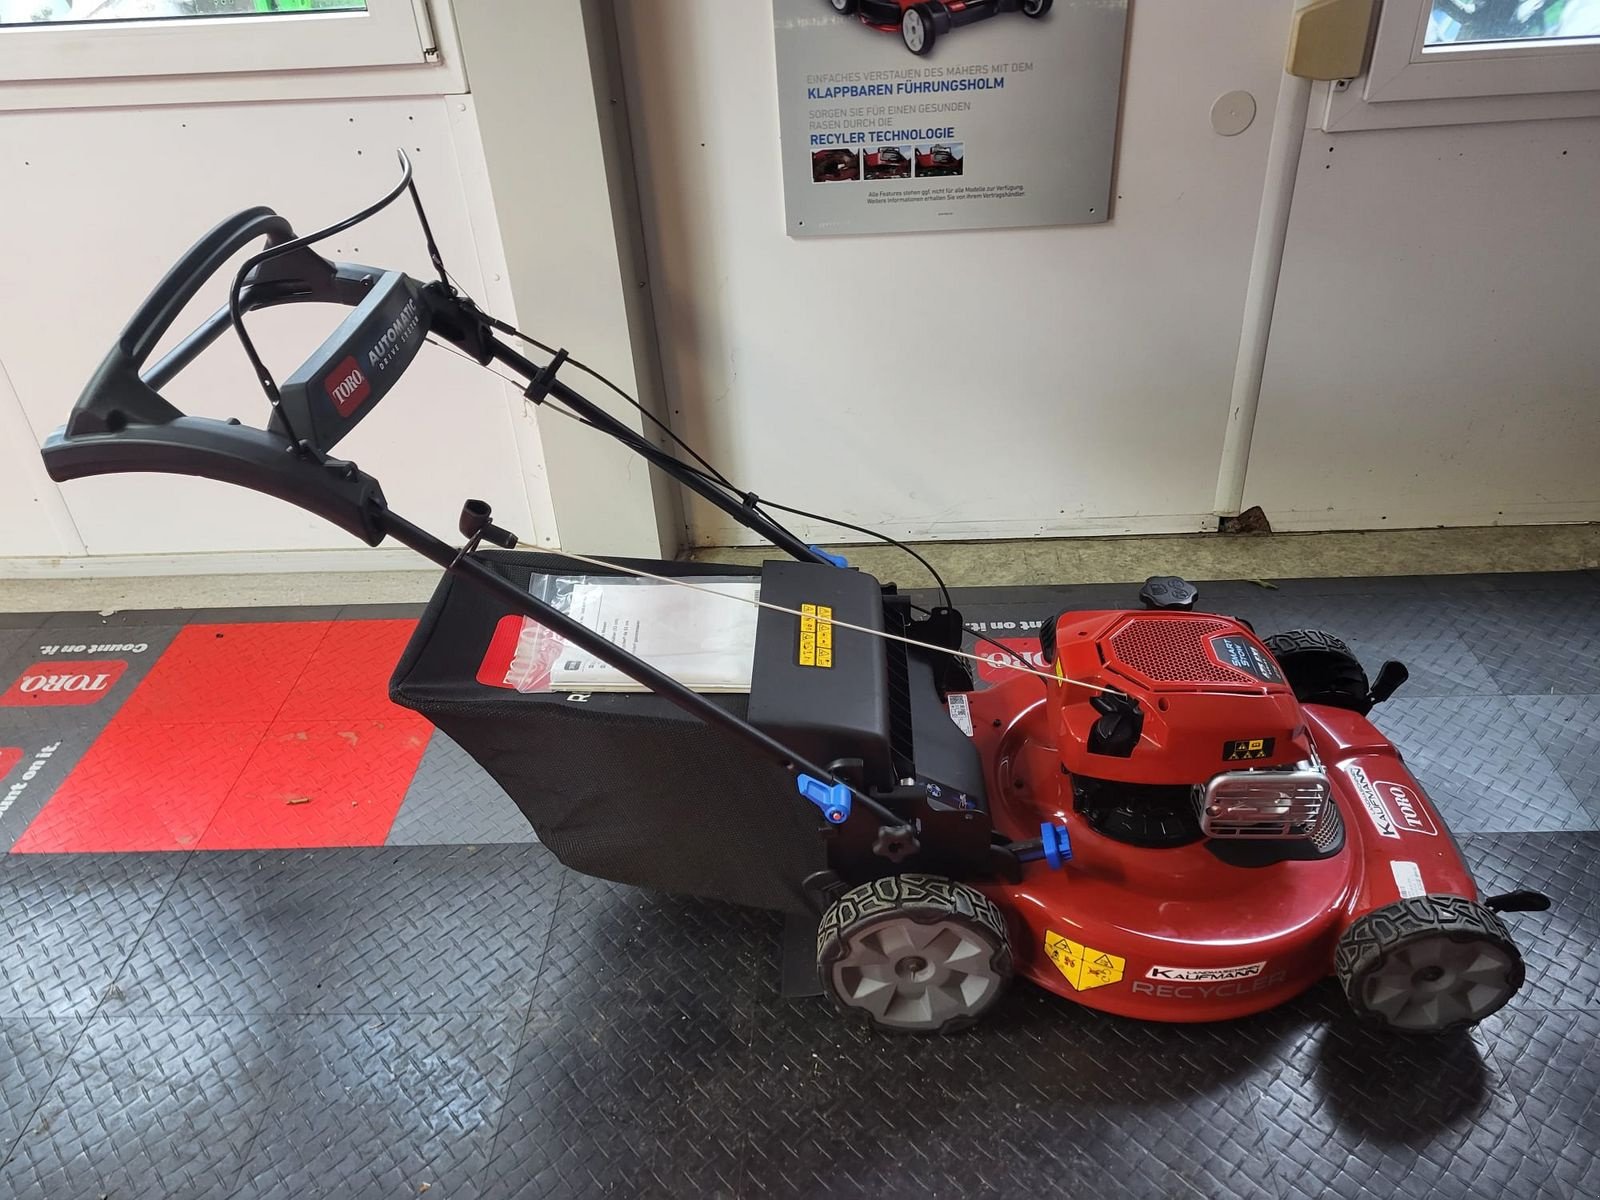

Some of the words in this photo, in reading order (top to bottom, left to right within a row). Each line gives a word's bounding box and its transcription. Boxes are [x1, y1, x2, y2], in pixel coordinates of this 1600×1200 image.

[807, 72, 861, 84] EINFACHES
[863, 69, 922, 81] VERSTAUEN
[924, 67, 945, 78] DES
[992, 63, 1009, 73] MIT
[1011, 62, 1033, 73] DEM
[808, 83, 893, 100] KLAPPBAREN
[896, 77, 1005, 95] FÜHRUNGSHOLM
[808, 108, 847, 120] SORGEN
[850, 107, 864, 118] SIE
[866, 105, 886, 117] FÜR
[888, 104, 917, 115] EINEN
[918, 102, 971, 114] GESUNDEN
[809, 120, 841, 130] RASEN
[843, 118, 876, 129] DURCH
[878, 117, 893, 127] DIE
[810, 132, 865, 145] RECYLER
[868, 127, 955, 142] TECHNOLOGIE
[368, 298, 417, 367] AUTOMATIC
[379, 345, 400, 371] DRIVE
[332, 369, 363, 405] TORO
[965, 622, 987, 632] it.
[991, 621, 1016, 630] on
[40, 645, 60, 655] it.
[61, 644, 87, 654] on
[87, 643, 148, 654] Count
[1223, 638, 1242, 667] SMART
[1234, 643, 1250, 667] STOW
[20, 673, 111, 693] TORO
[22, 760, 47, 780] on
[35, 742, 61, 758] it.
[1356, 767, 1396, 835] KAUFMANN
[1389, 786, 1423, 828] TORO
[1132, 970, 1287, 999] RECYCLER
[1152, 966, 1259, 981] KAUFMANN
